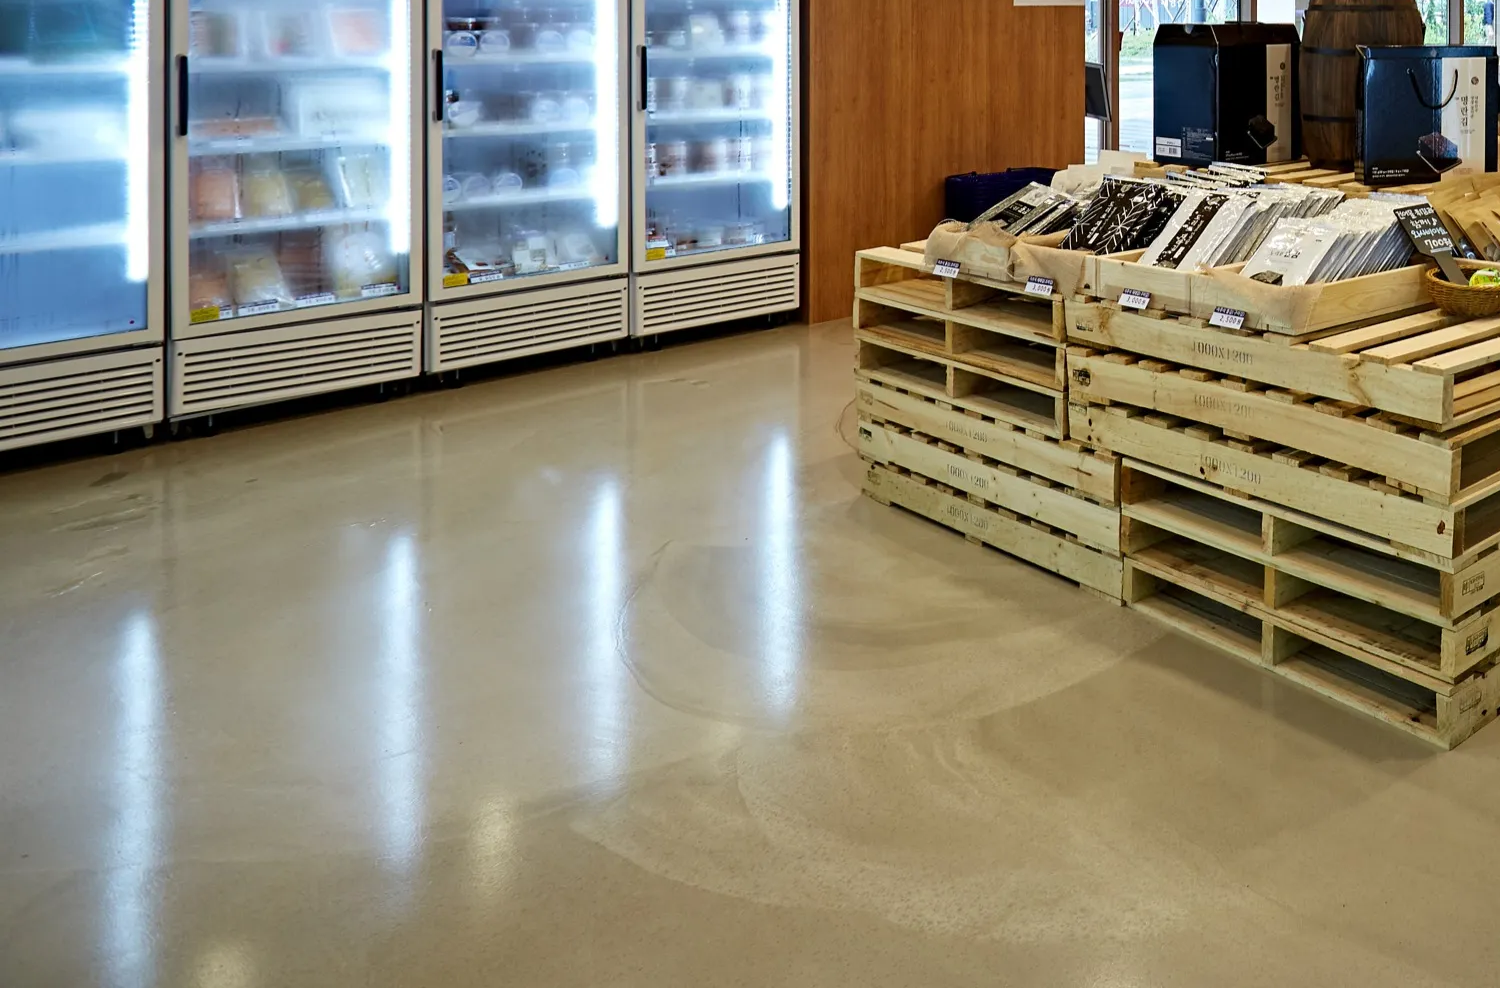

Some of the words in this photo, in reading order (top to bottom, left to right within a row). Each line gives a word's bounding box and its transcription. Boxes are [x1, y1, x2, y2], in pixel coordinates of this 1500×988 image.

[1460, 95, 1468, 127] 명란김
[1219, 315, 1242, 326] 2,500원
[1192, 341, 1253, 365] 1000X1200
